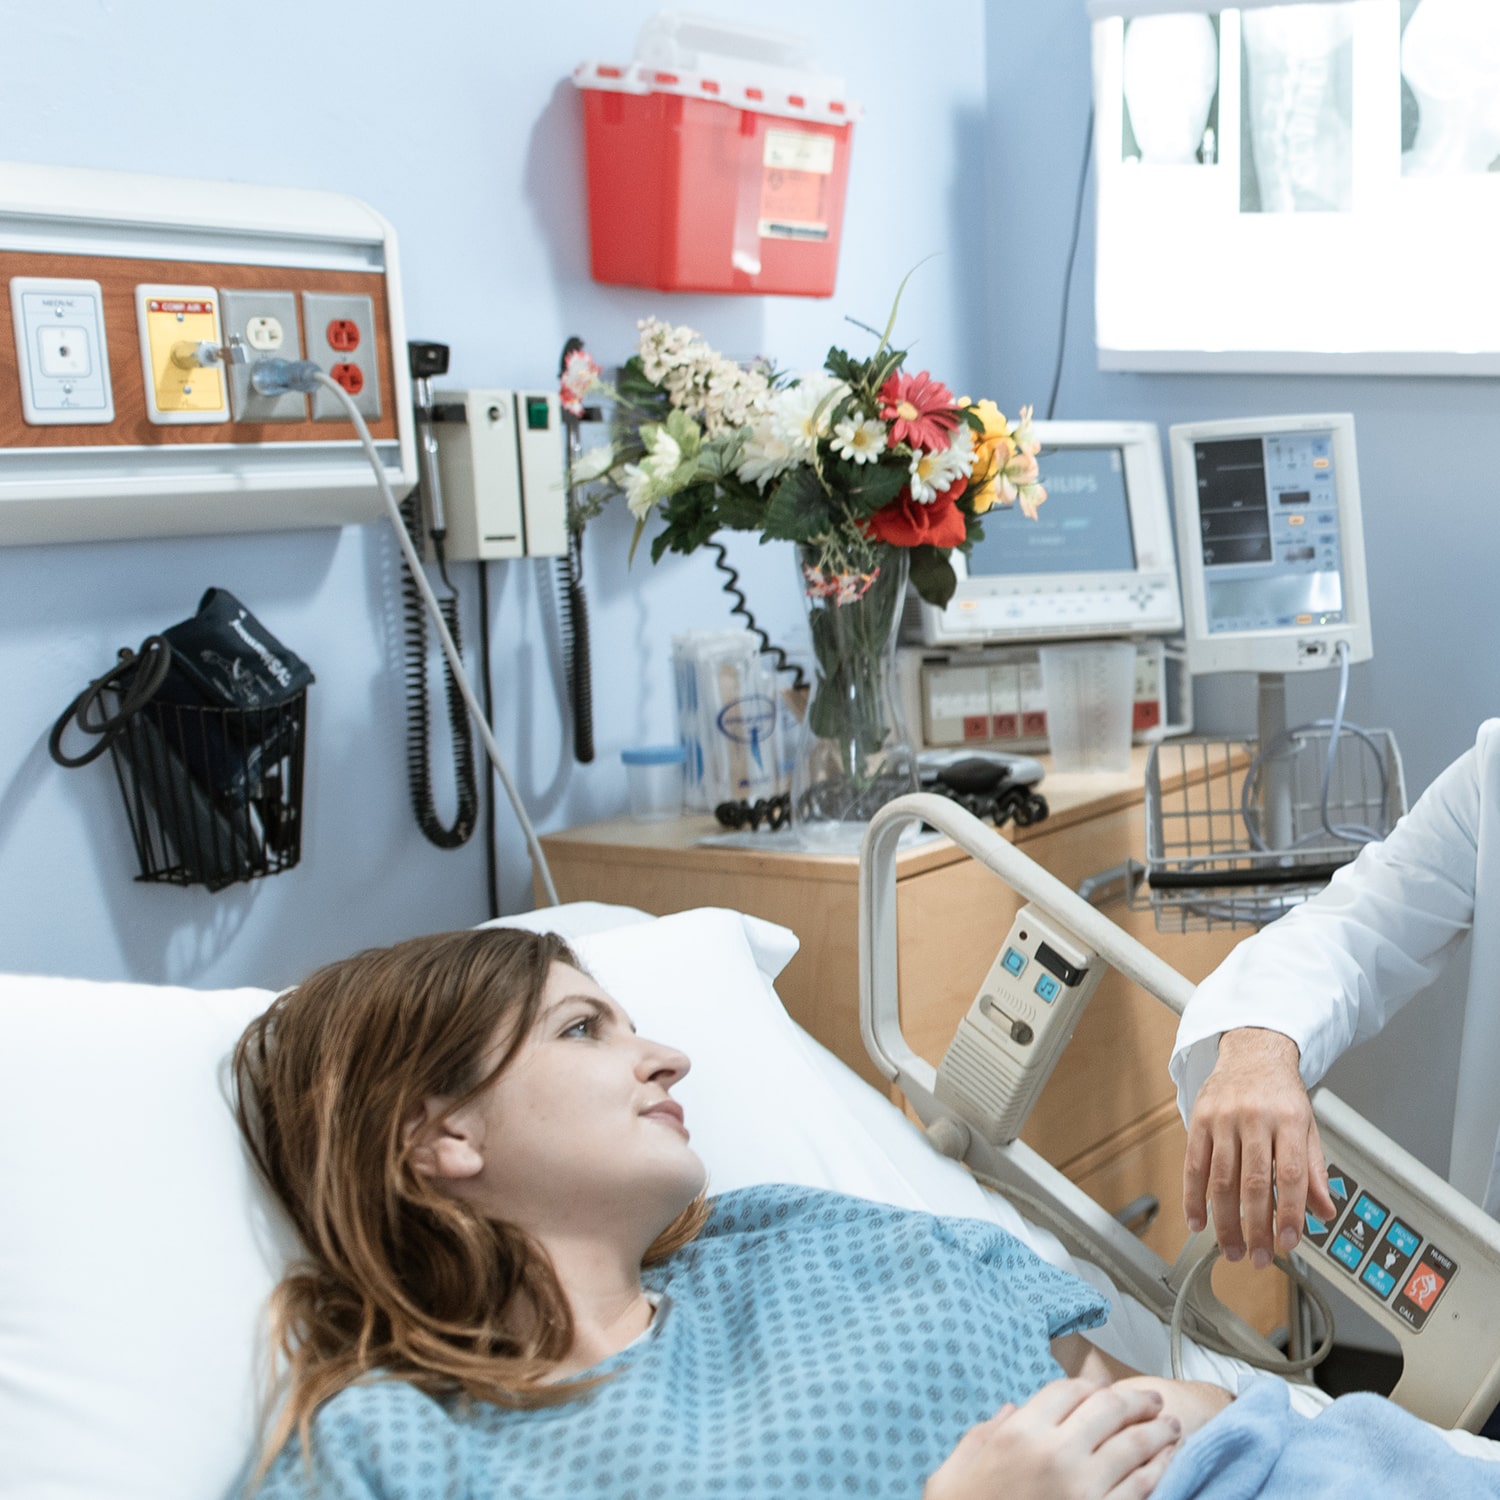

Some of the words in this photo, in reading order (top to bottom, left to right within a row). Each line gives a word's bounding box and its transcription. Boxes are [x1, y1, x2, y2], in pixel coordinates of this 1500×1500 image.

[1394, 1228, 1415, 1246] ROOM
[1430, 1248, 1453, 1271] NURSE
[1398, 1305, 1415, 1323] CALL
